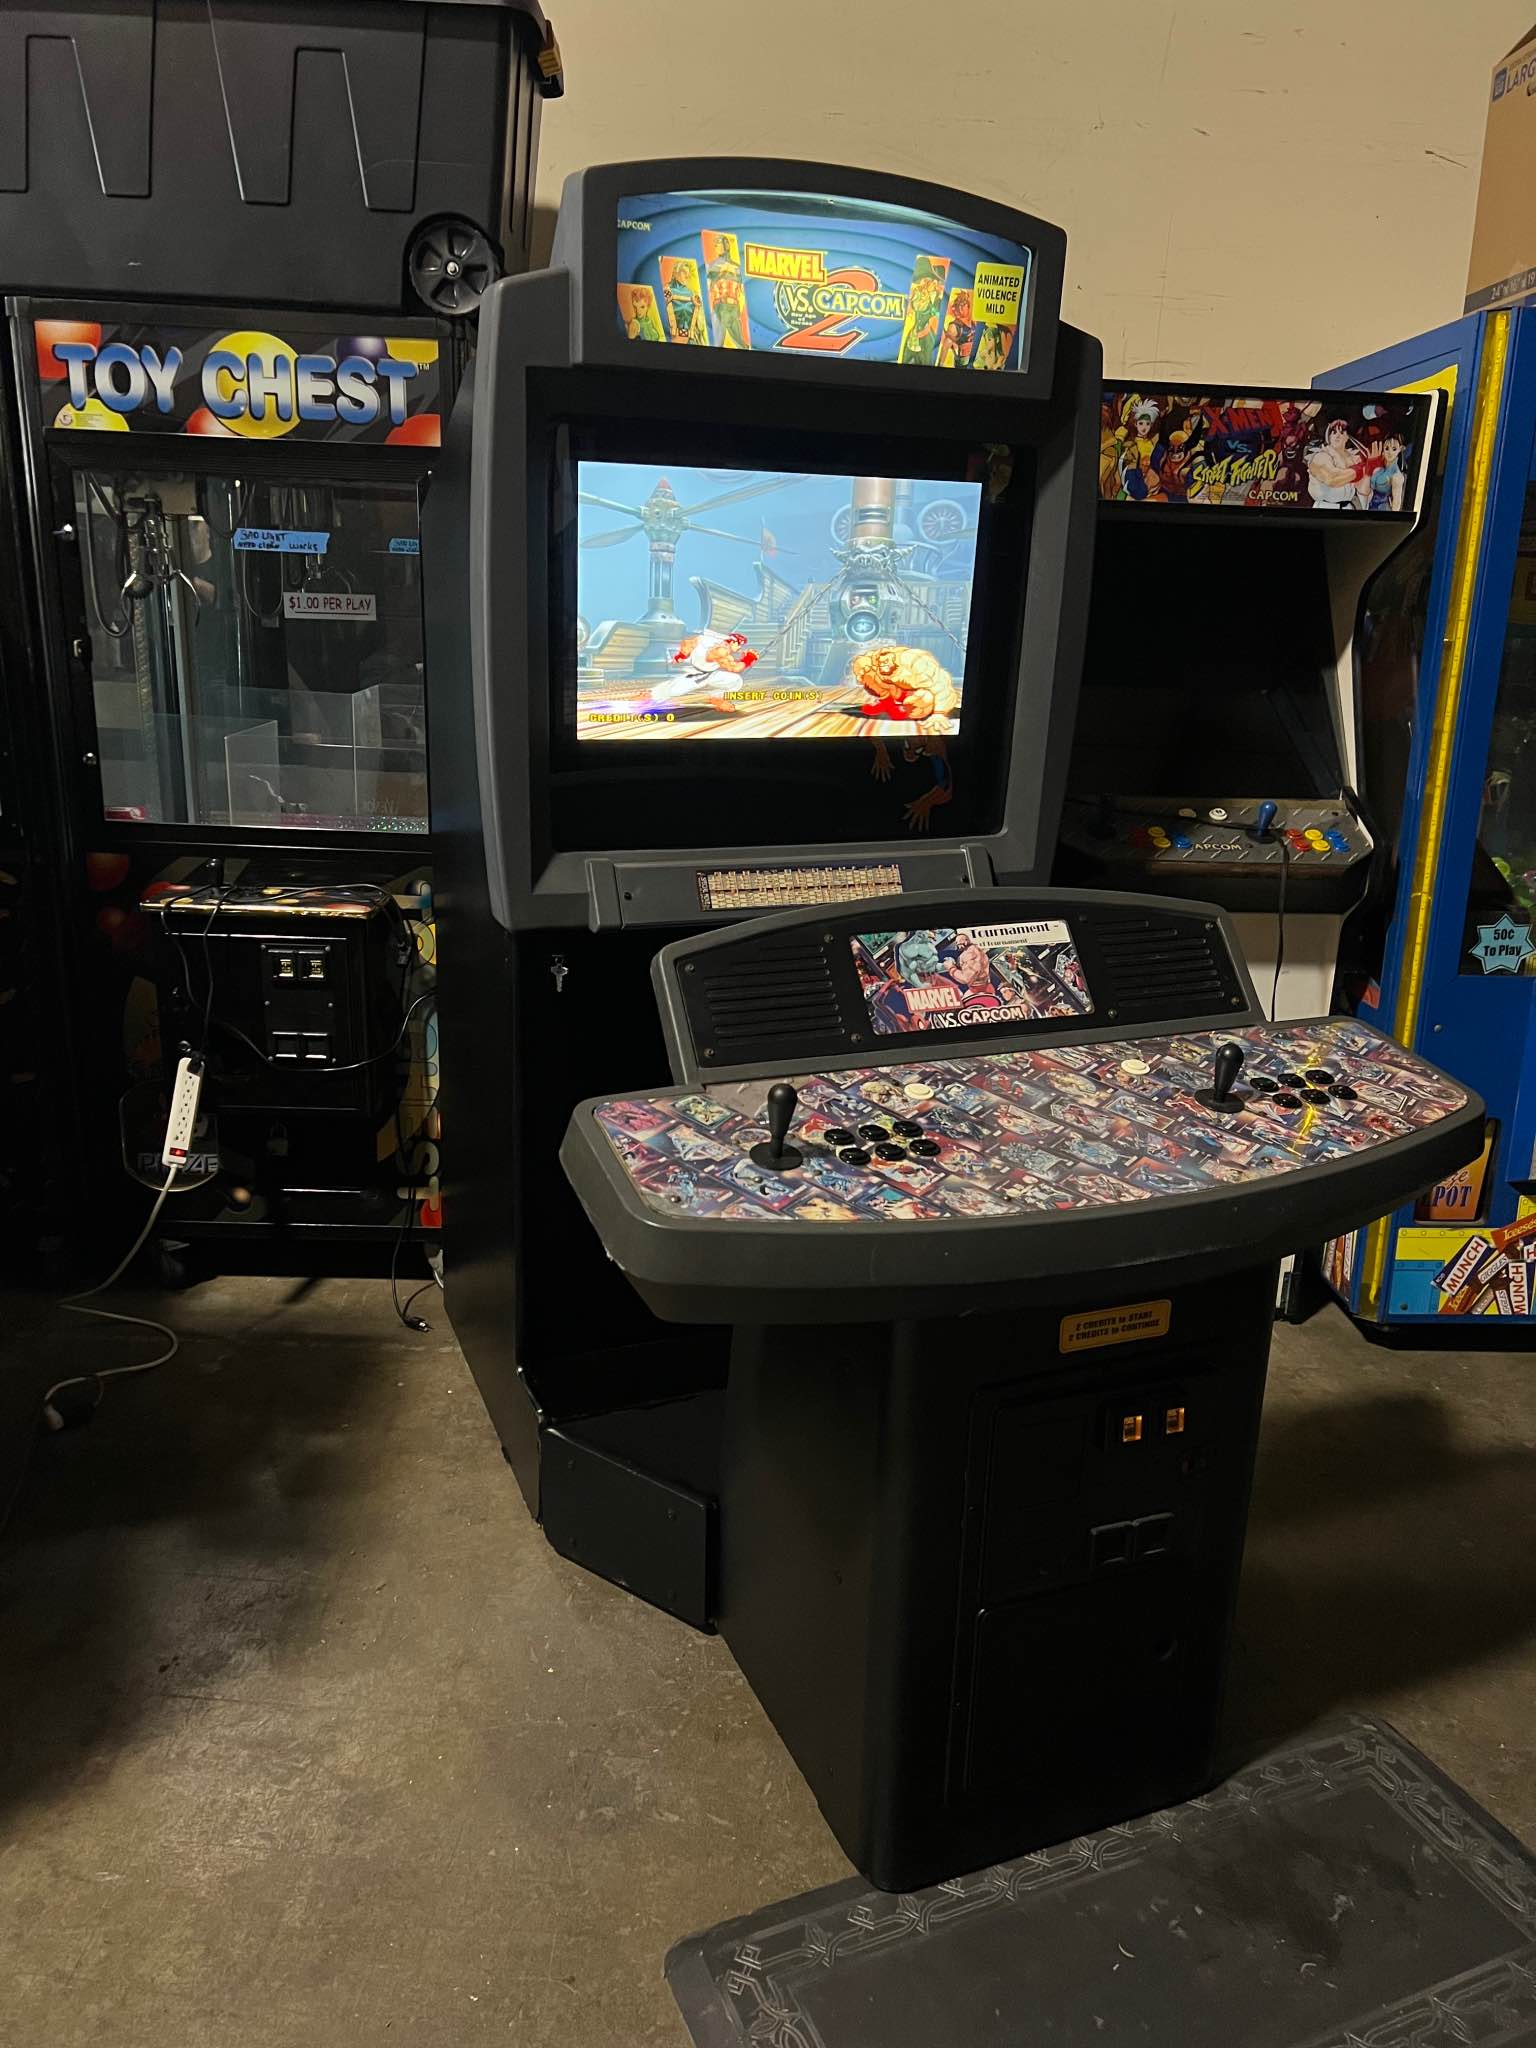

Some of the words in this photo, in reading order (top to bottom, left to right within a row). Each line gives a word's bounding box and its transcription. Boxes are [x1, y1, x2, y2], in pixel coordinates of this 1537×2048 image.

[747, 245, 825, 282] MARVEL
[978, 273, 1020, 288] ANIMATED
[784, 285, 814, 314] VS.
[815, 289, 903, 317] CAPCOM
[977, 288, 1018, 302] VIOLENCE
[777, 268, 879, 354] 2
[985, 302, 1005, 315] MILD
[53, 343, 183, 414] TOY
[202, 351, 418, 425] CHEST
[1247, 489, 1298, 502] CAPCOM
[289, 596, 319, 610] $1.00
[323, 597, 342, 610] PER
[346, 597, 372, 611] PLAY
[724, 691, 767, 701] INSERT
[772, 691, 824, 701] COIN(S)
[588, 713, 659, 722] CREDIT(S)
[1194, 843, 1242, 851] APCOM
[970, 922, 1051, 939] Tournament
[1484, 945, 1497, 957] To
[1498, 945, 1522, 957] Play
[906, 987, 961, 1012] MARVEL
[959, 1006, 1026, 1026] CAPCOM
[1446, 1239, 1484, 1292] MUNCH
